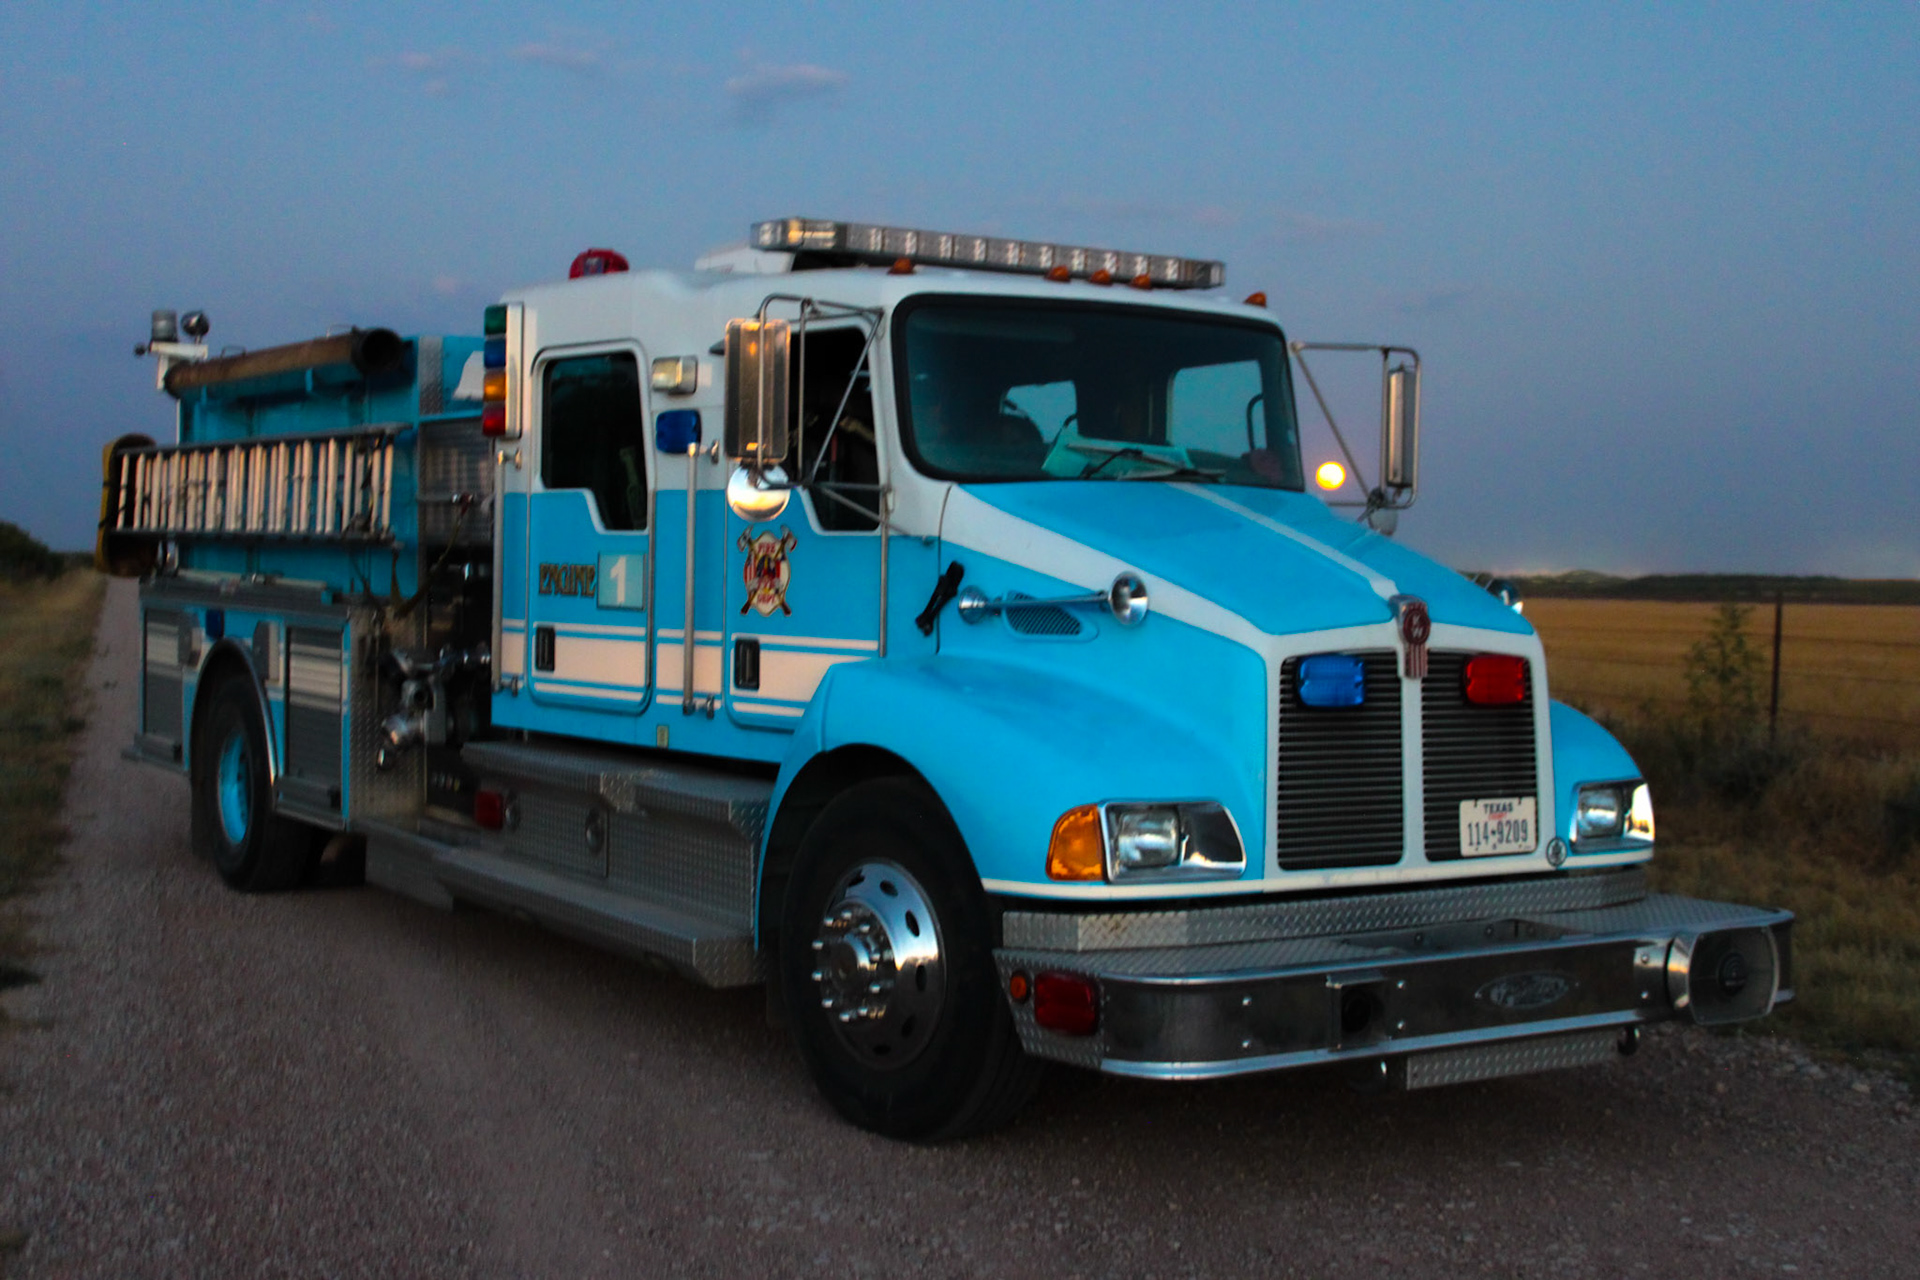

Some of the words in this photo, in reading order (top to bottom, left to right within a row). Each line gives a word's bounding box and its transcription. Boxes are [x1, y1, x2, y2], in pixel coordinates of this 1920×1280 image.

[539, 563, 596, 598] ENGINE
[609, 556, 627, 604] 1
[1482, 801, 1514, 815] TEXAS
